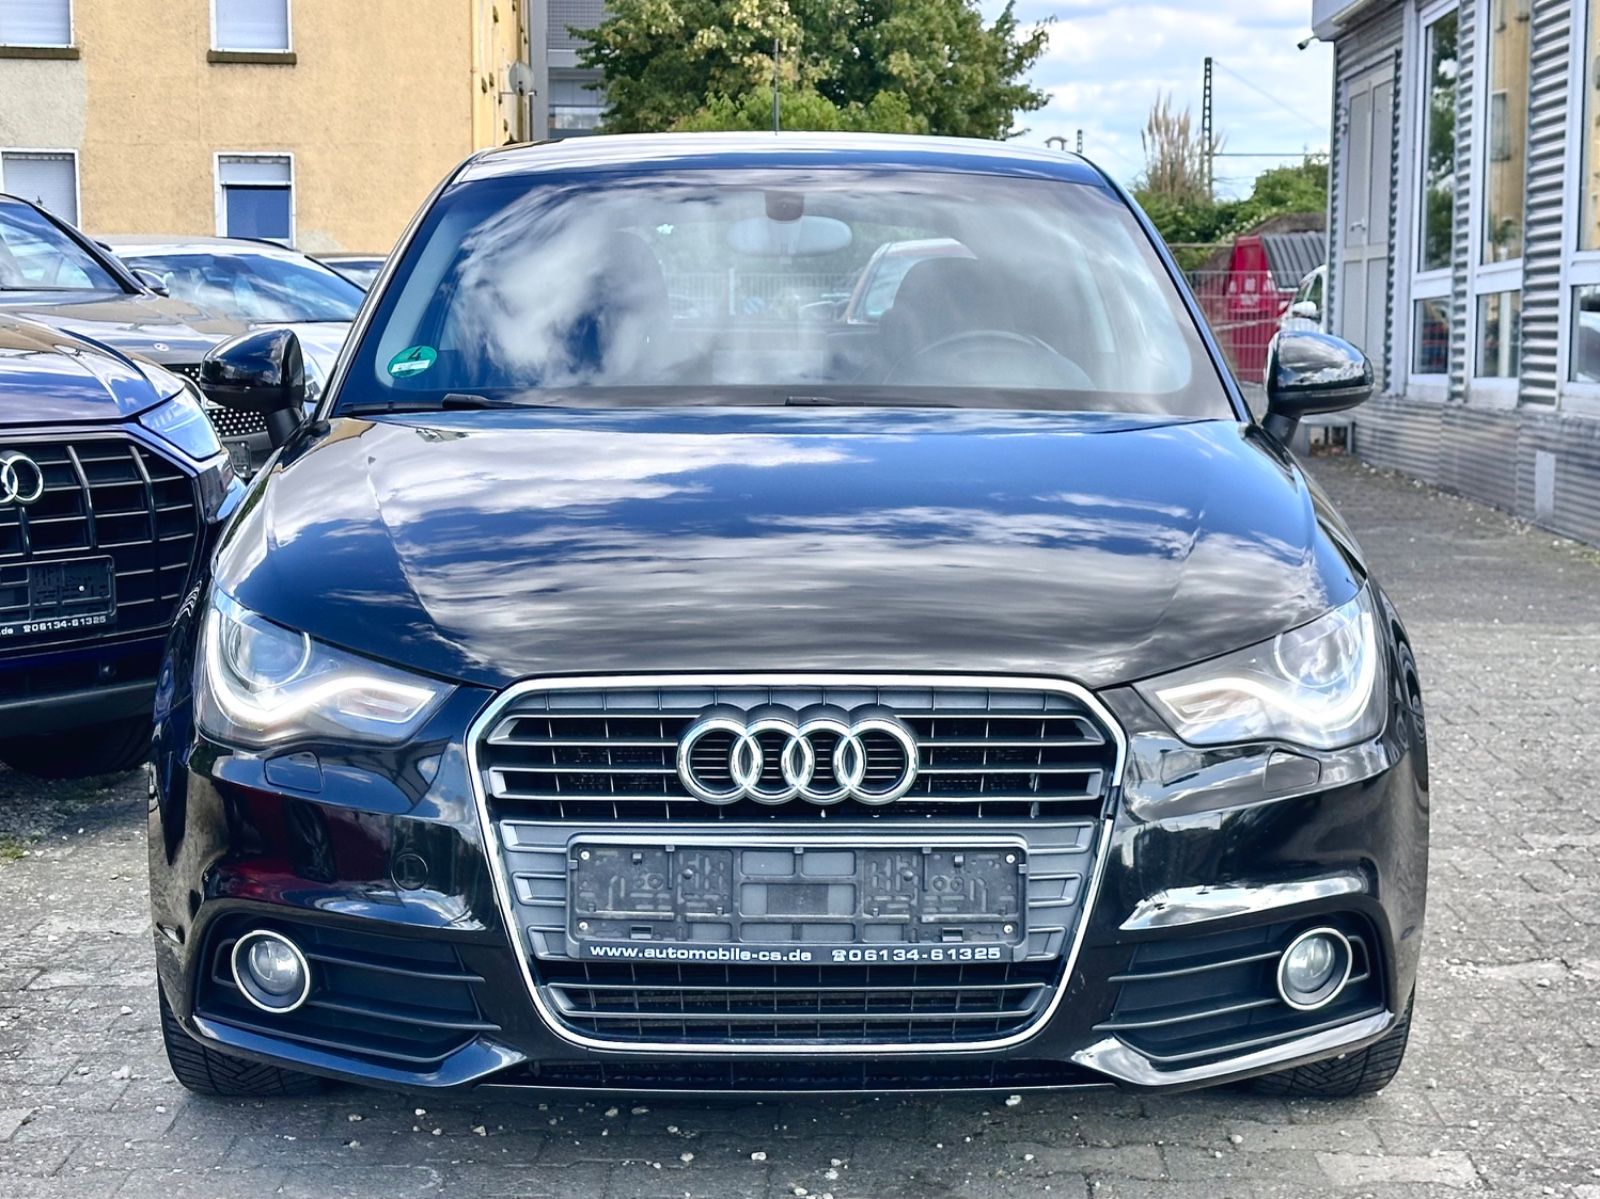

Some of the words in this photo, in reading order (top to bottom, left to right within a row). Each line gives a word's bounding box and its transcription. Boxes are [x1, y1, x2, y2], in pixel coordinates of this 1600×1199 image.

[409, 346, 422, 360] 4
[590, 946, 811, 962] www.automobile-cs.de
[848, 947, 1001, 962] 06134-61325
